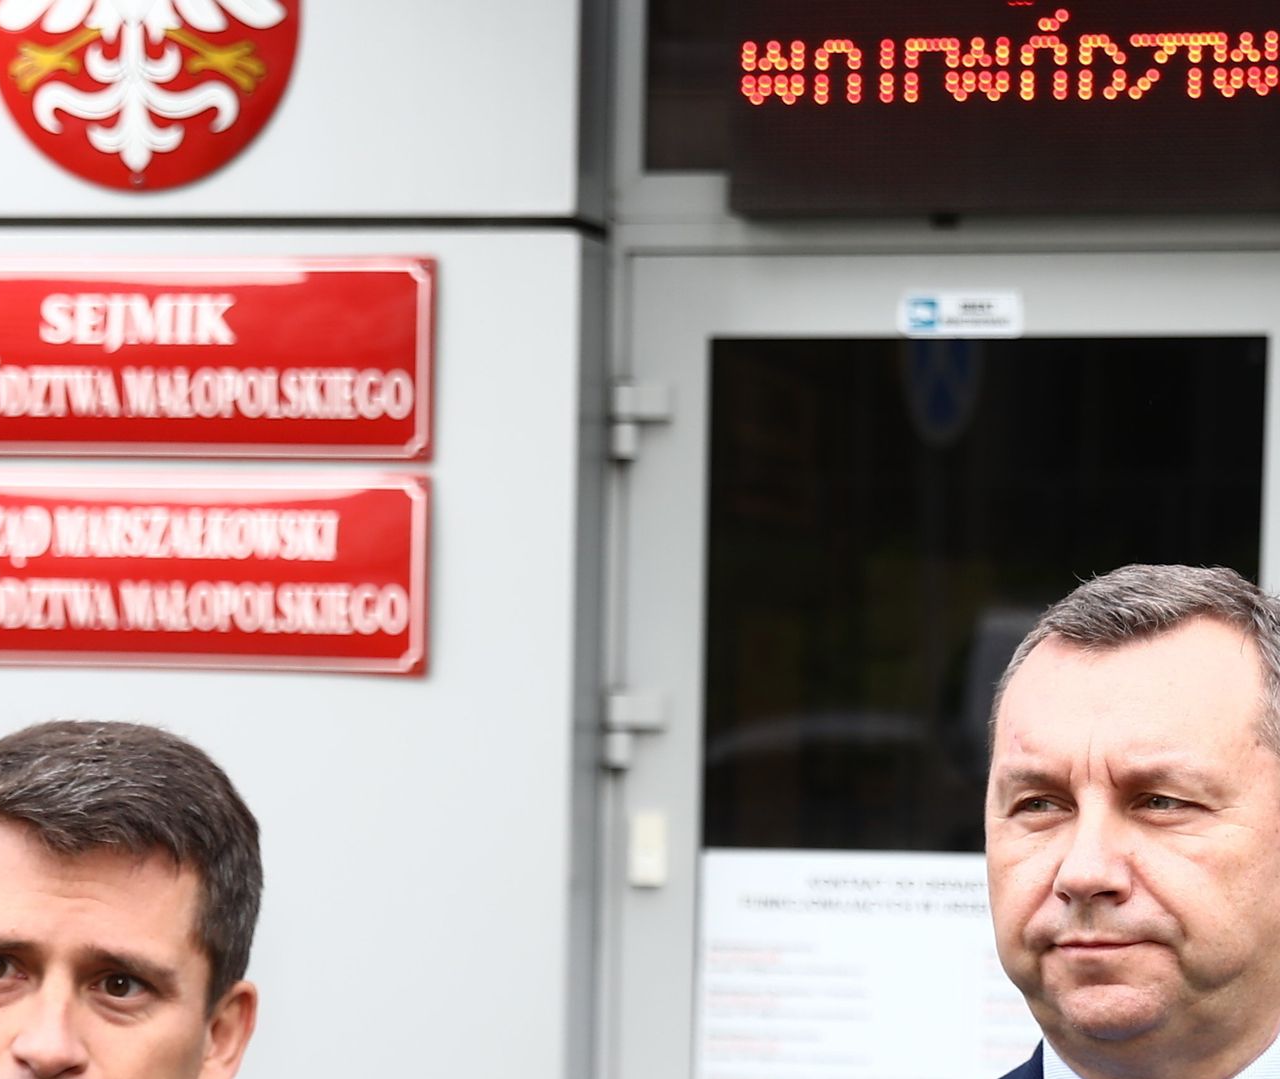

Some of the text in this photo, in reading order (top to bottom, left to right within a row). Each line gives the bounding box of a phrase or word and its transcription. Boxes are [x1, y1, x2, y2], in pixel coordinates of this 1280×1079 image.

[39, 293, 236, 352] SEJMIK
[122, 366, 414, 420] MAŁOPOLSKIEGO
[54, 506, 340, 562] MARSZAŁKOWSKI
[120, 579, 409, 635] MAŁOPOLSKIEGO
